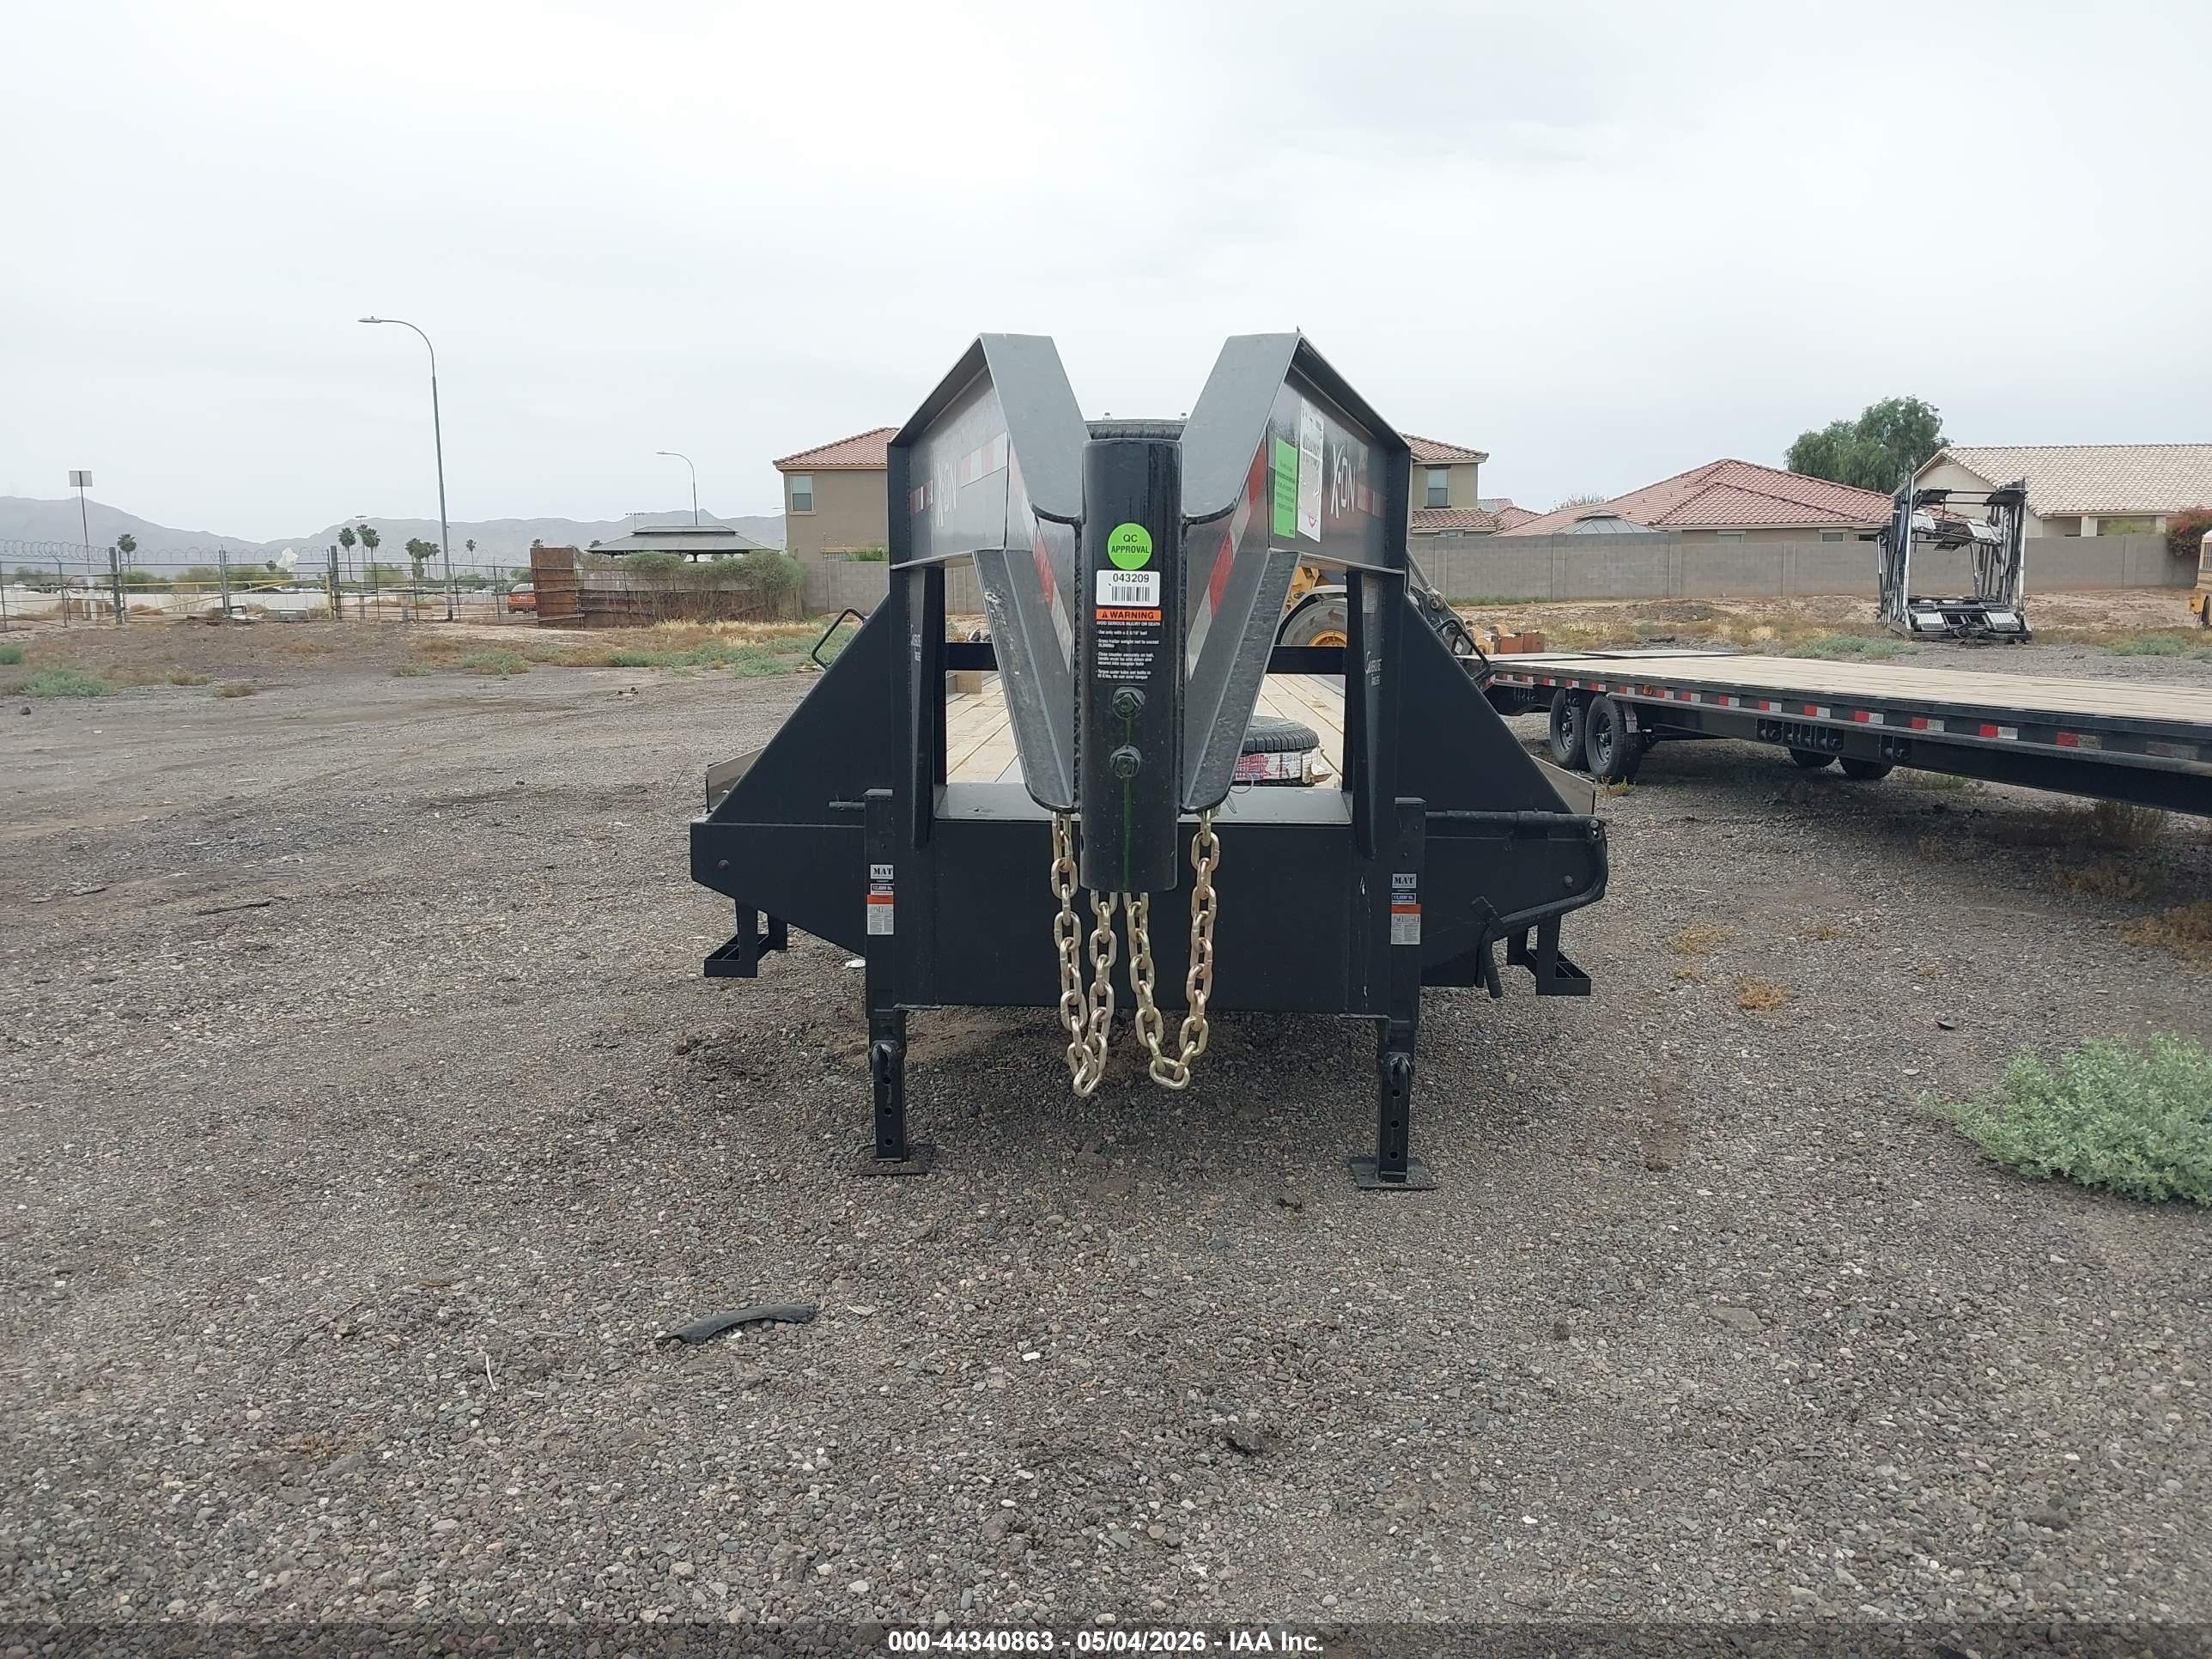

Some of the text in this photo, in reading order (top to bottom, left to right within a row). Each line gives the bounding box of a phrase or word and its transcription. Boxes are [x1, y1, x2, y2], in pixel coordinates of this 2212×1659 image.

[1122, 534, 1138, 543] QC
[1111, 545, 1150, 554] APPROVAL
[1112, 573, 1150, 583] 043209
[1110, 611, 1154, 619] WARNING
